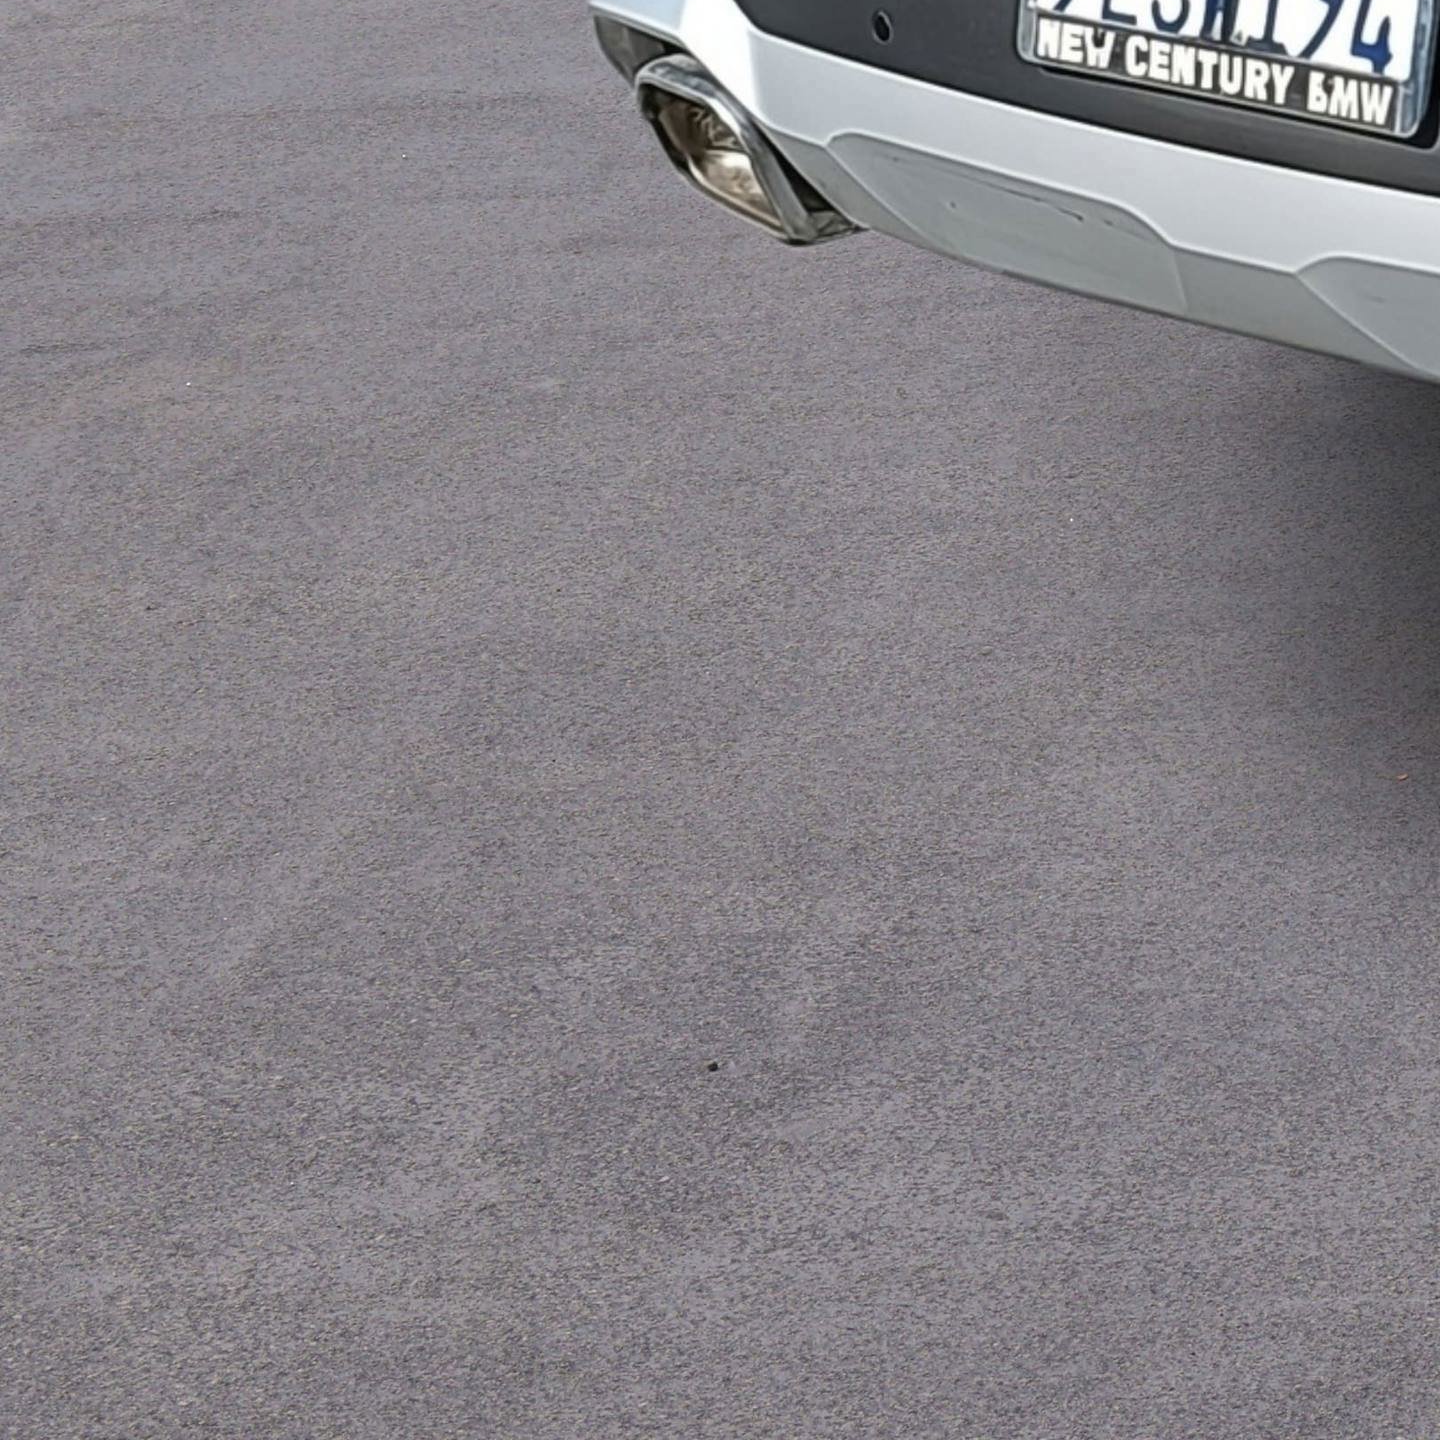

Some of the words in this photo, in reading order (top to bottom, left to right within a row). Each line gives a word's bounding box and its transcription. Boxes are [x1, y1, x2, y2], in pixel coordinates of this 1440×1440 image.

[1036, 18, 1116, 69] NEW
[1125, 36, 1295, 105] CENTURY
[1306, 73, 1393, 126] BMW
